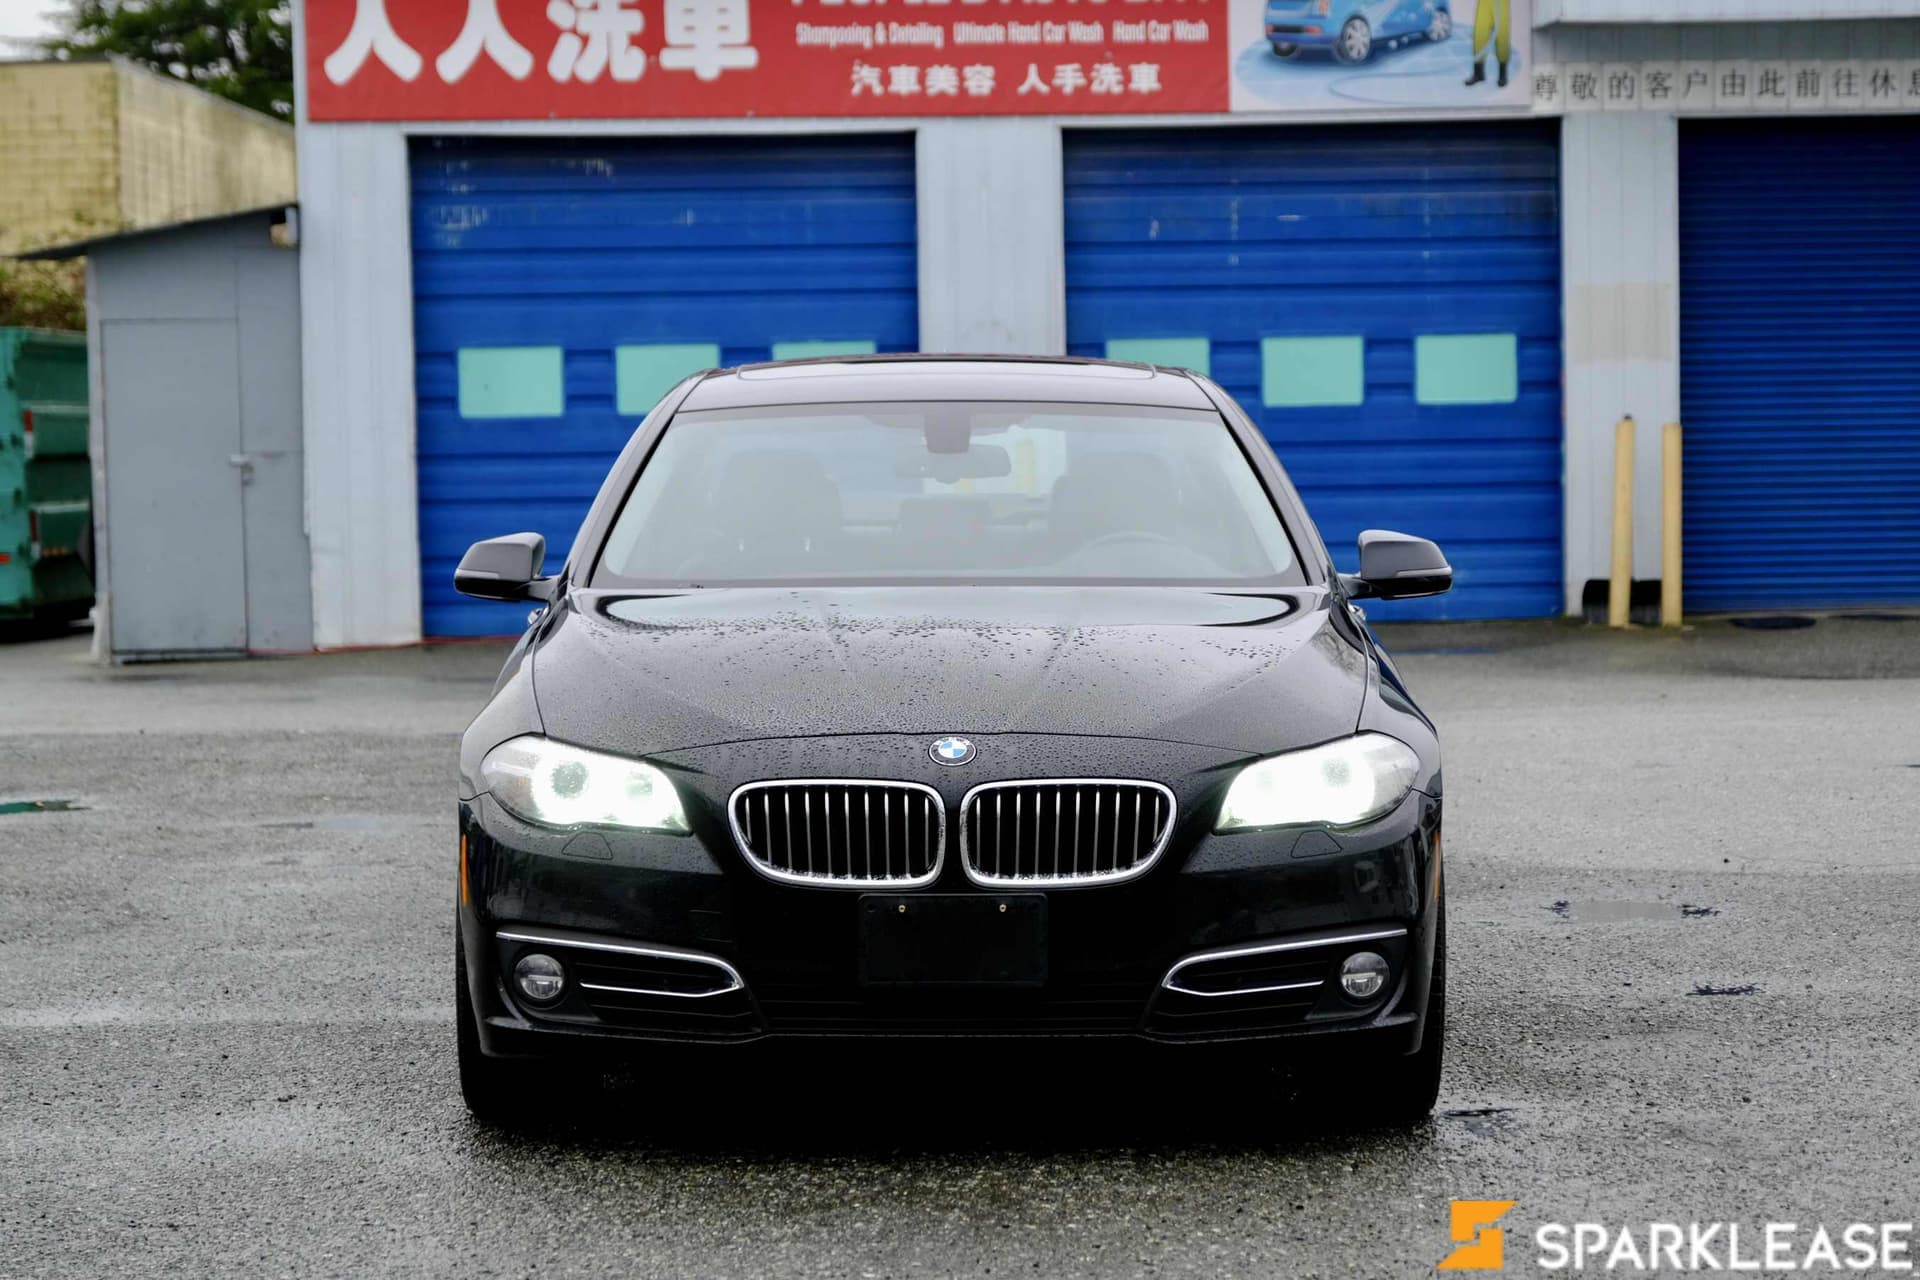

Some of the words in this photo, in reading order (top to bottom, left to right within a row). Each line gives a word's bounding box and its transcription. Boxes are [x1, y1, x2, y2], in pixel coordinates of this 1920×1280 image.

[324, 0, 759, 85] 人人洗車
[875, 22, 886, 45] &
[889, 22, 944, 49] Detailing
[953, 21, 1005, 44] Ultimate
[1007, 21, 1040, 44] Hand
[1042, 20, 1066, 43] Car
[1067, 20, 1104, 43] Wash
[1112, 20, 1146, 43] Hand
[1148, 19, 1171, 42] Car
[1172, 19, 1209, 42] Wash
[851, 60, 996, 96] 汽車美容
[1017, 62, 1162, 95] 人手洗車
